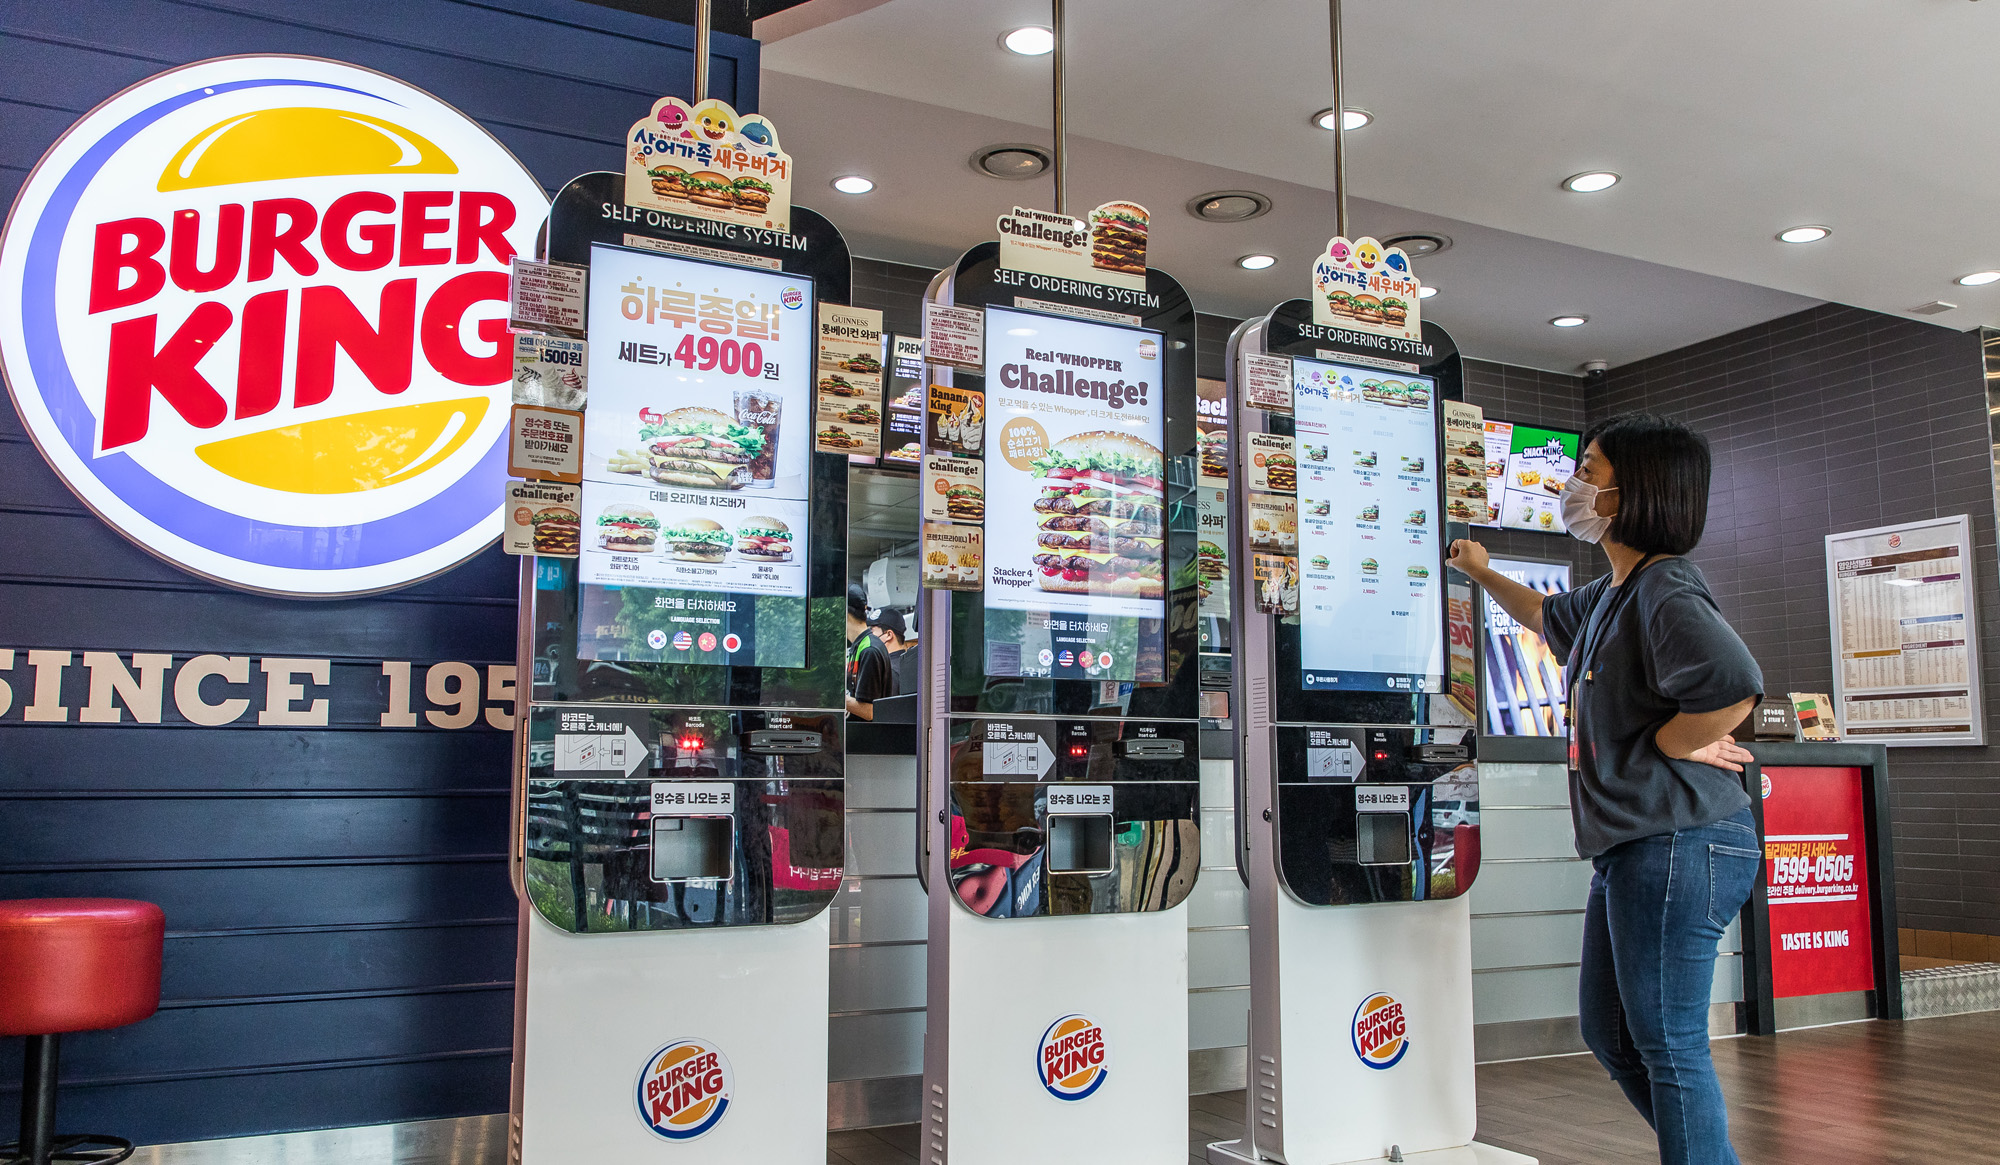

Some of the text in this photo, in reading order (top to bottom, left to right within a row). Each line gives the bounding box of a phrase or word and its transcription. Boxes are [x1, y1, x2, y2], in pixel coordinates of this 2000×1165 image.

[634, 128, 786, 179] 상어가족 새우버거
[1015, 208, 1073, 226] Real WHOPPER
[602, 203, 641, 223] SELF
[646, 211, 737, 239] ORDERING
[743, 227, 807, 251] SYSTEM
[999, 217, 1088, 248] Challenge!
[89, 191, 516, 314] BURGER
[1316, 262, 1416, 299] 상어가족 새우버거
[782, 290, 802, 299] BURGER
[993, 269, 1160, 308] SELF ORDERING SYSTEM
[783, 296, 803, 304] KING
[620, 281, 780, 342] 하루종일!
[831, 314, 869, 327] GUINNESS
[821, 323, 859, 338] 통베이컨
[1298, 323, 1433, 357] SELF ORDERING SYSTEM
[101, 271, 513, 450] KING
[539, 348, 582, 367] 1500원
[618, 333, 780, 381] 세트가 4900원
[1025, 348, 1122, 372] Real WHOPPER
[999, 363, 1149, 409] Challenge!
[1295, 383, 1330, 399] 상어가족
[930, 387, 969, 403] Banana
[930, 400, 952, 414] King
[998, 397, 1014, 407] 믿고
[1014, 399, 1030, 410] 먹을
[1030, 402, 1038, 411] 수
[1038, 402, 1053, 413] 있는
[1090, 410, 1098, 418] 더
[1098, 411, 1113, 420] 크게
[1452, 409, 1476, 420] GUINNESS
[525, 417, 571, 432] 영수증 또는
[644, 414, 659, 423] NEW
[891, 413, 896, 421] 3
[521, 428, 573, 443] 주문번호표를
[1008, 426, 1036, 438] 100%
[525, 439, 569, 454] 받아가세요
[1007, 437, 1042, 449] 순쇠고기
[1252, 438, 1292, 450] Challenge!
[1009, 447, 1043, 458] 패티 4장!
[1523, 448, 1543, 458] SNACK
[929, 462, 978, 475] Challenge!
[512, 488, 574, 503] Challenge!
[649, 491, 746, 509] 더블 오리지널 치즈버거
[1255, 557, 1286, 569] Banana
[1838, 558, 1872, 571] 영양성분표
[993, 567, 1033, 578] Stacker 4
[1255, 567, 1272, 580] King
[654, 597, 737, 613] 화면을 터치하세요
[670, 615, 721, 625] LANGUAGE SELECTION
[1043, 619, 1109, 633] 화면을 터치하세요
[1491, 614, 1510, 627] FOR
[1492, 627, 1509, 635] SINCE
[0, 649, 331, 726] INCE
[561, 712, 595, 723] 바코드는
[561, 721, 623, 733] 오른쪽 스캐너에!
[987, 723, 1013, 732] 바코드는
[987, 731, 1036, 740] 오른쪽 스캐너에!
[1309, 730, 1331, 740] 바코드는
[654, 792, 731, 806] 영수증 나오는 곳
[1049, 794, 1111, 805] 영수증 나오는 곳
[1357, 793, 1407, 804] 영수증 나오는 곳
[1765, 842, 1837, 859] 딜리버리 킹 서비스
[1773, 855, 1854, 884] 1599-0505
[1783, 885, 1794, 896] 주문
[1795, 883, 1859, 895] delivery.burgerking.co.kr
[1781, 929, 1850, 951] TASTE IS KING
[1357, 1003, 1403, 1037] BURGER
[1360, 1016, 1405, 1057] KING
[1045, 1027, 1102, 1064] BURGER
[1047, 1042, 1104, 1086] KING
[647, 1052, 719, 1101] BURGER
[652, 1068, 723, 1126] KING
